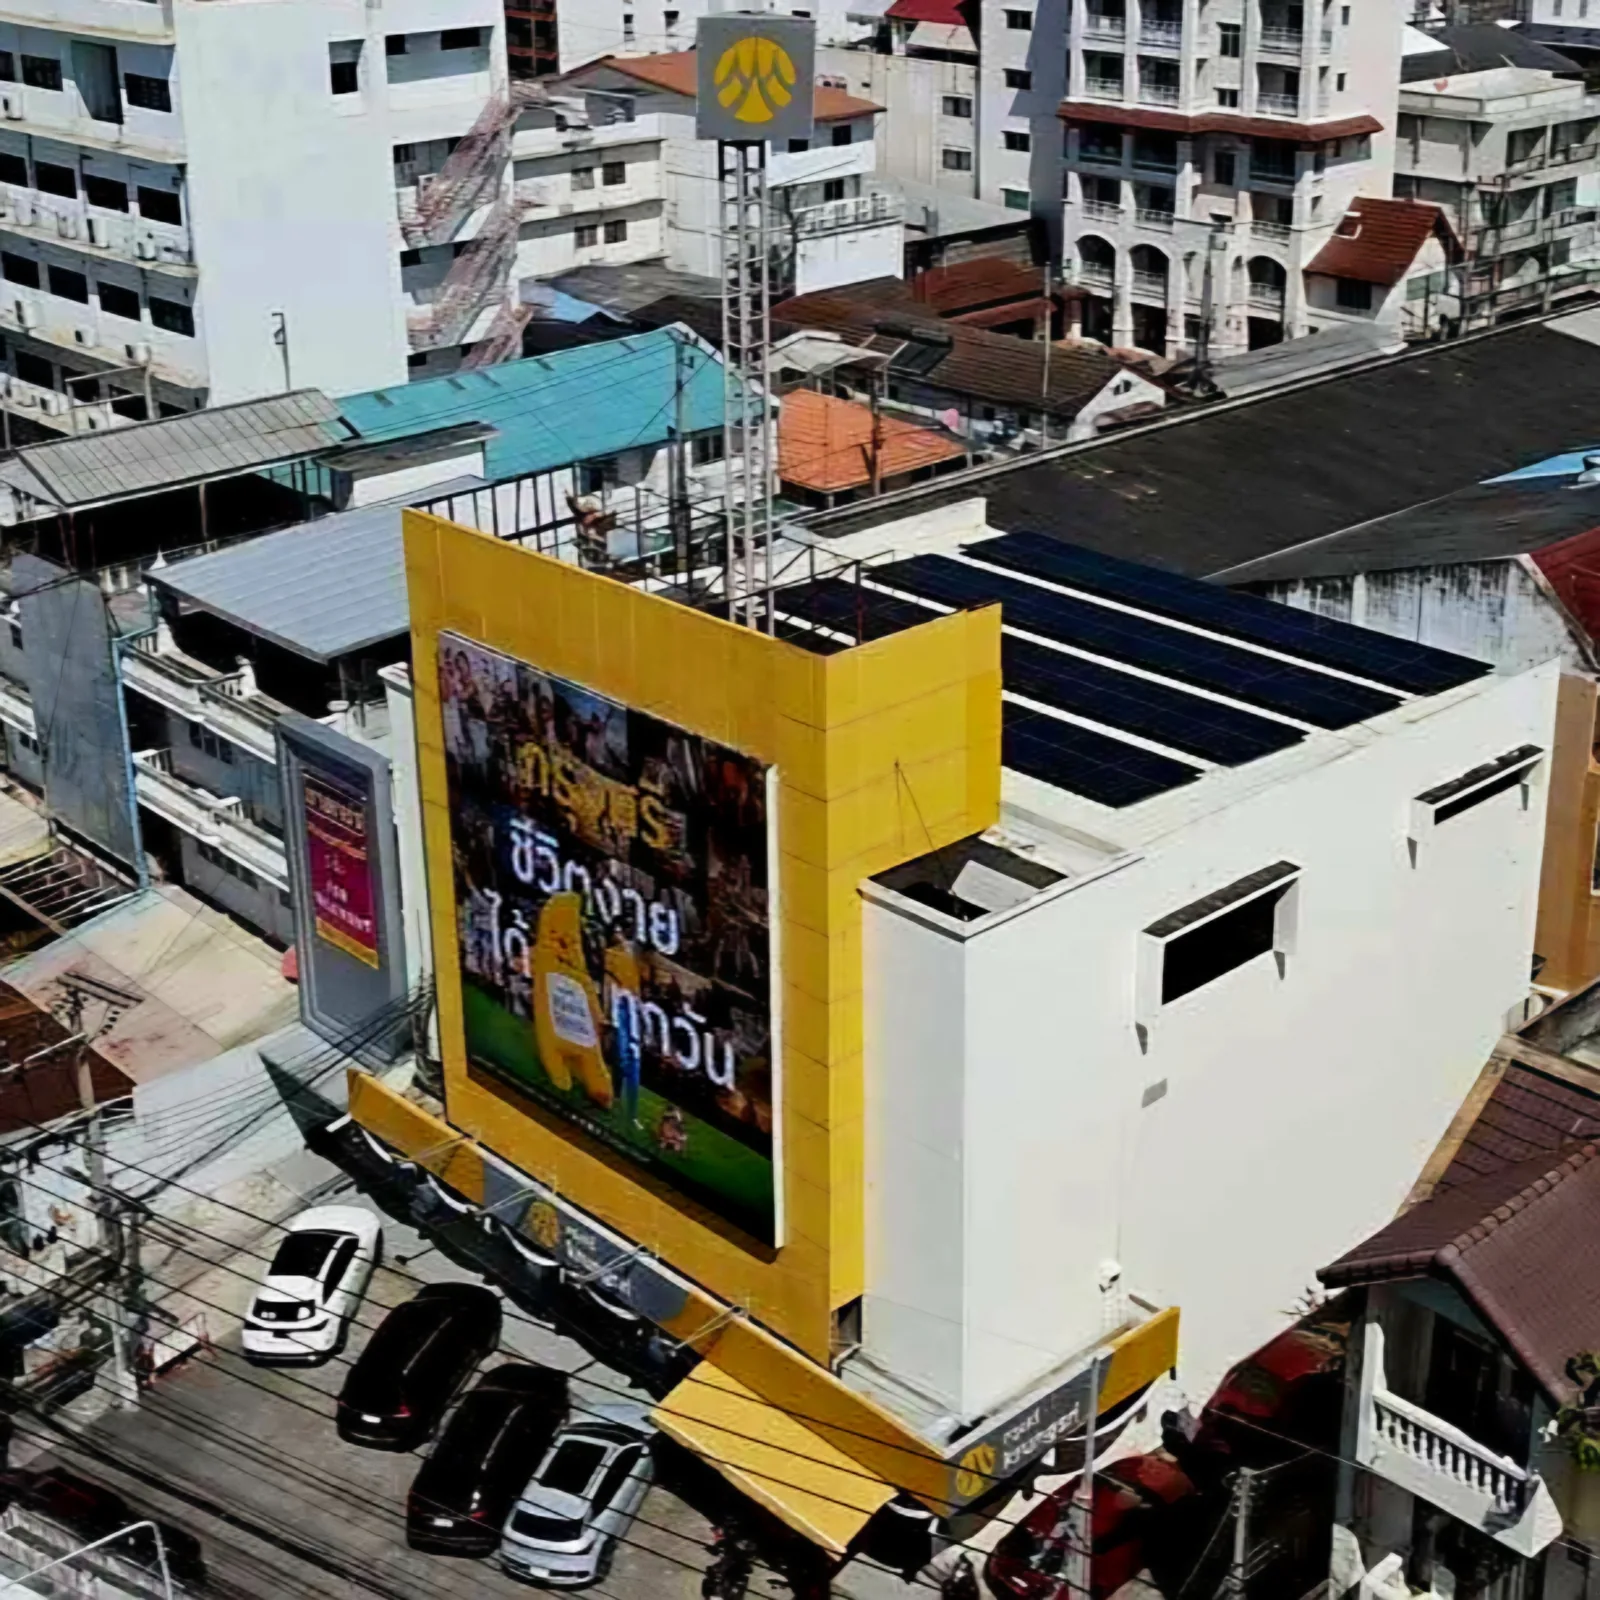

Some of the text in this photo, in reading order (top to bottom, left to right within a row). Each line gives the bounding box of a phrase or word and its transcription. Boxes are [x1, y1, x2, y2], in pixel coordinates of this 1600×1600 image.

[482, 887, 532, 979] ได้
[611, 983, 735, 1091] ทุกวัน
